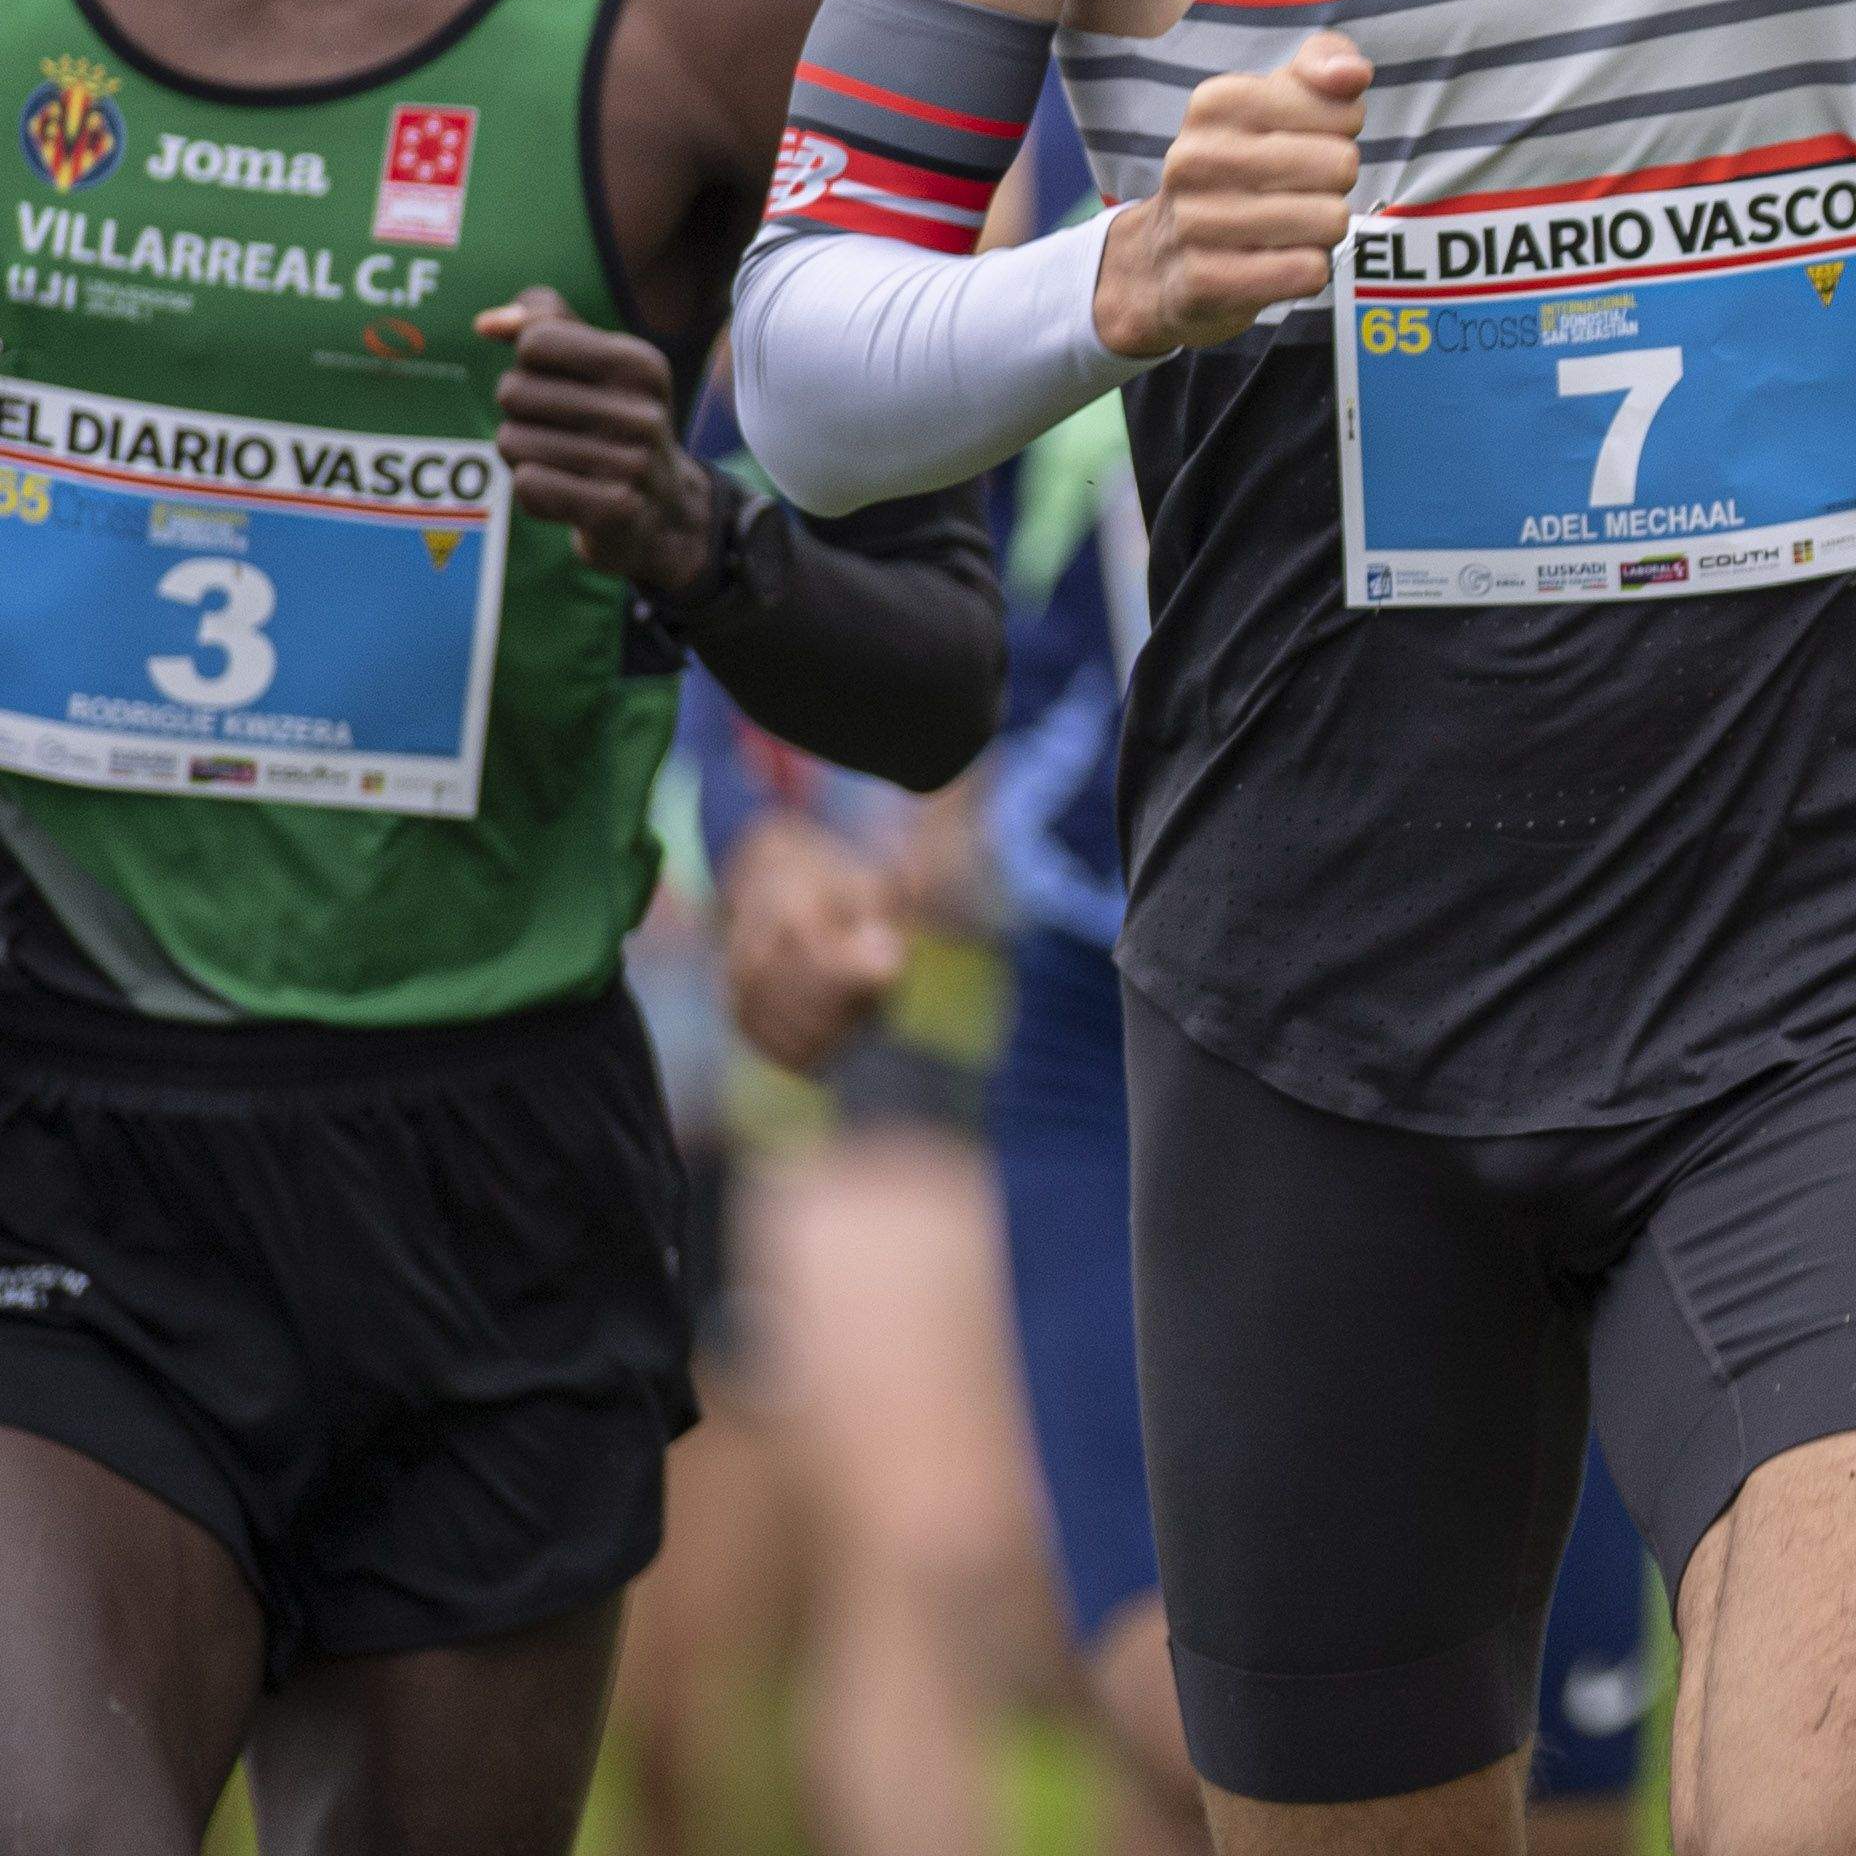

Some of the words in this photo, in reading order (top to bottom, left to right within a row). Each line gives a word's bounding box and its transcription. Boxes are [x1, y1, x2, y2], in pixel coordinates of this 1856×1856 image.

[146, 133, 331, 196] Joma
[17, 200, 344, 300] VILLARREAL
[1353, 230, 1427, 282] EL
[1438, 210, 1654, 280] DIARIO
[1360, 307, 1432, 356] 65
[1433, 307, 1540, 354] Cross
[66, 407, 278, 482] DIARIO
[292, 443, 491, 502] VASCO
[1556, 346, 1684, 509] 7
[1520, 512, 1597, 545] ADEL
[1604, 498, 1746, 538] MECHAAL
[146, 557, 278, 713] 3
